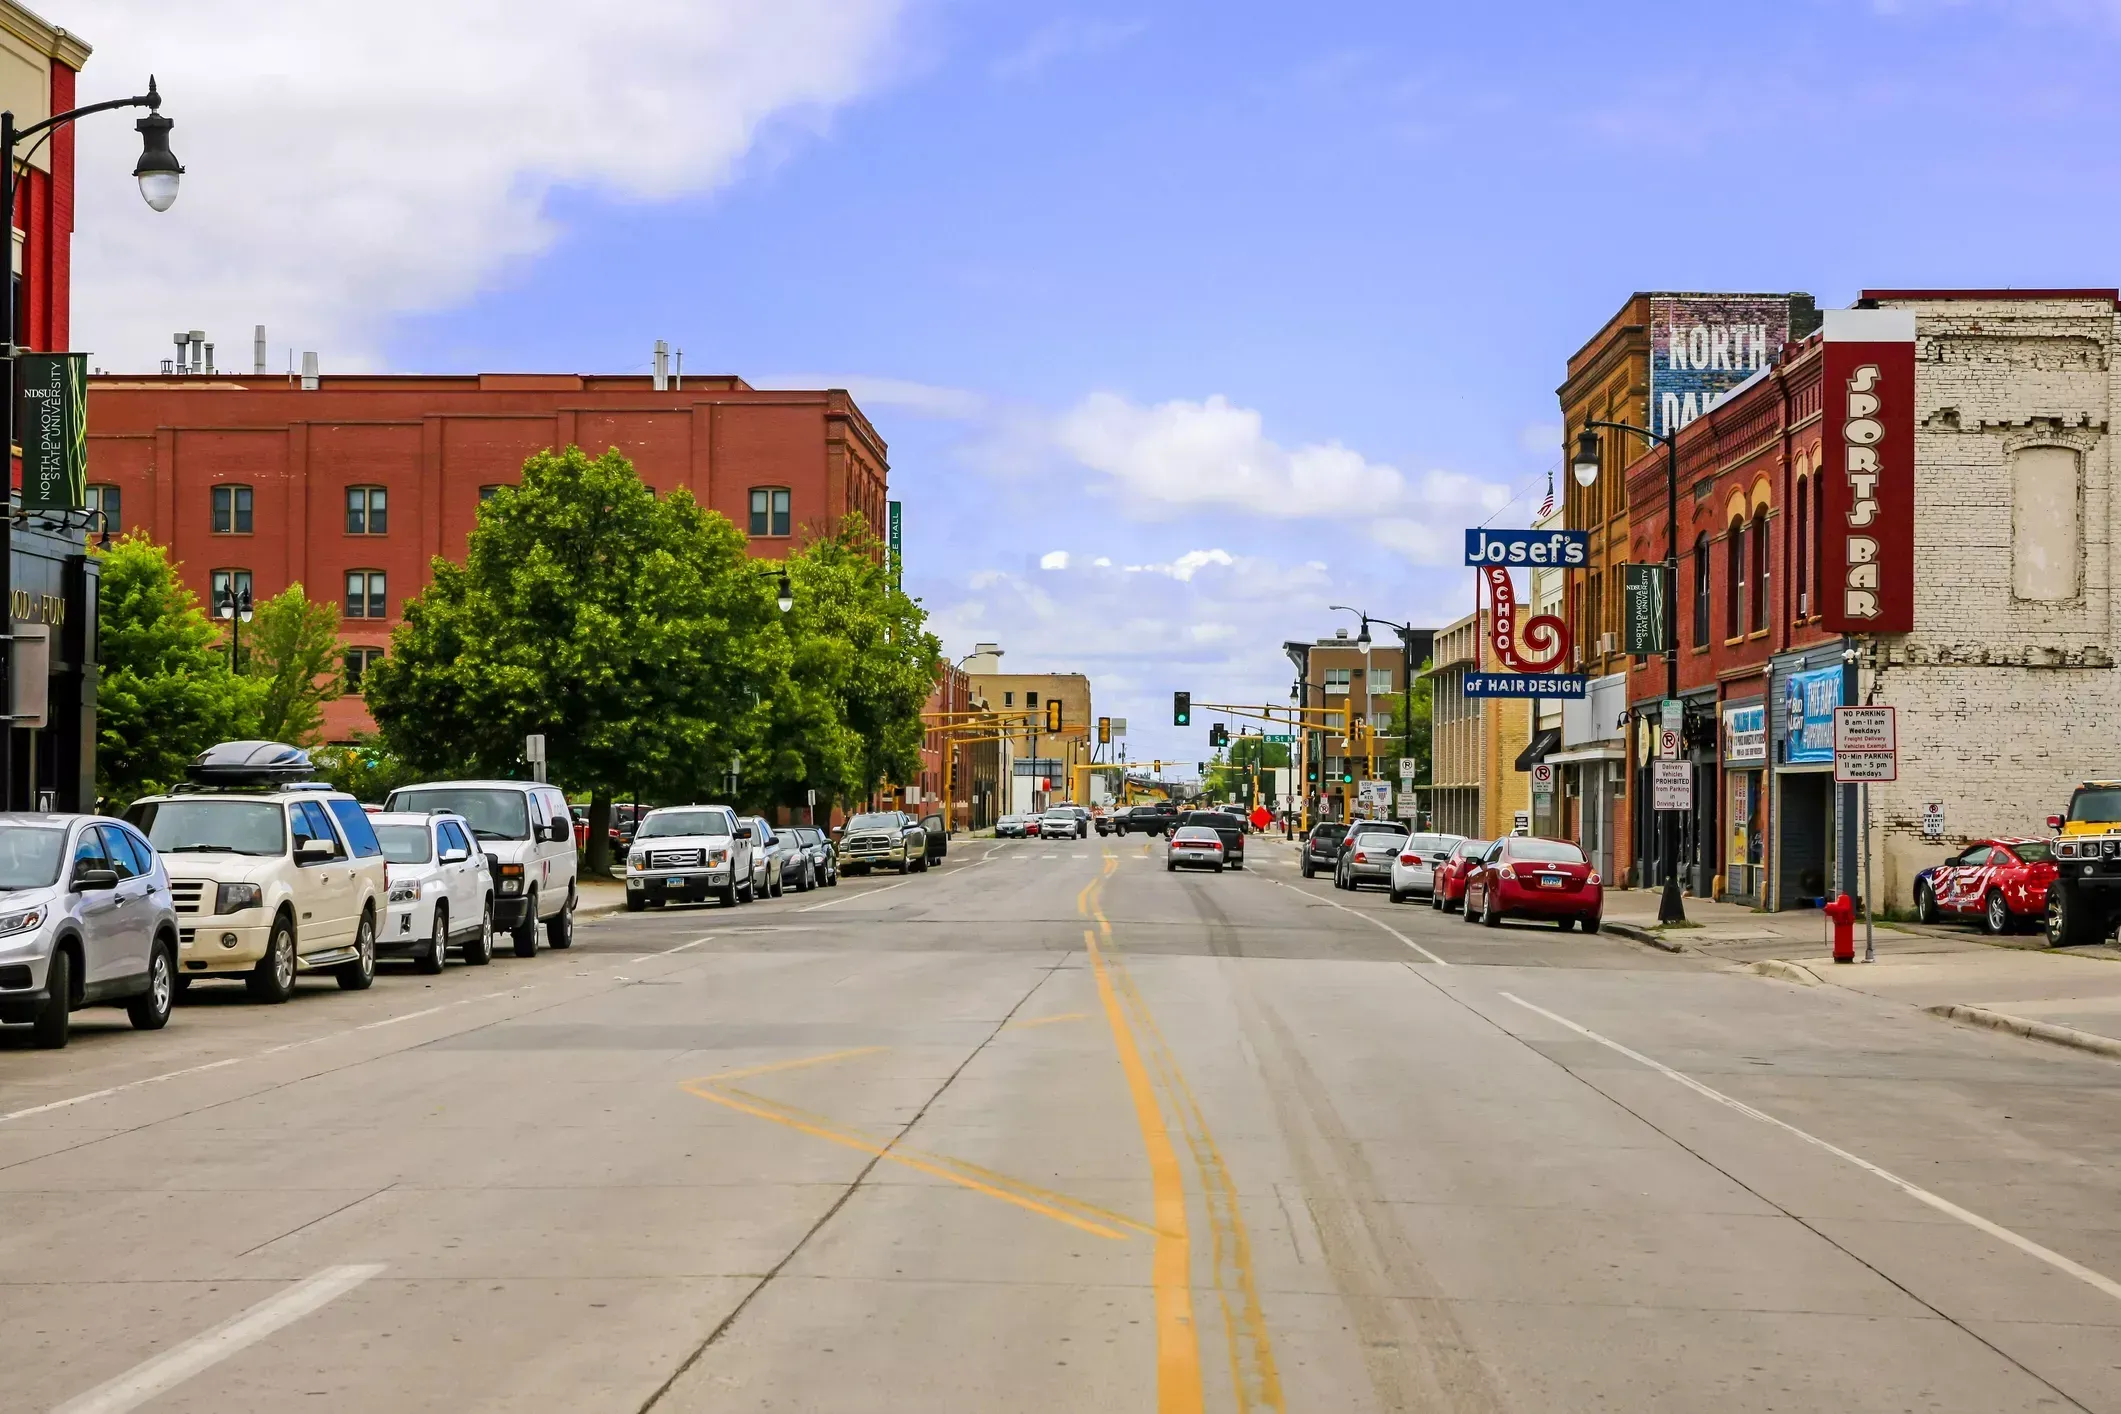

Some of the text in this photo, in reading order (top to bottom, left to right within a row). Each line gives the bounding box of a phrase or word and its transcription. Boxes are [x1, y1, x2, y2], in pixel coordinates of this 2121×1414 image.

[1669, 324, 1766, 370] NORTH
[24, 389, 51, 398] NDSU
[51, 361, 61, 480] STATE UNIVERSITY
[41, 398, 51, 500] NORTH DAKOTA
[1843, 364, 1884, 619] SPORTS BAR
[1469, 532, 1584, 563] Josef's
[41, 594, 65, 625] FUN
[1492, 569, 1517, 666] SCHOOL
[1466, 679, 1582, 693] of HAIR DESIGN
[1791, 697, 1803, 713] BUD
[1789, 714, 1804, 730] LIGHT
[1848, 727, 1881, 735] Weekdays
[1661, 763, 1683, 771] Delivery
[1849, 770, 1882, 778] Weekdays
[1656, 800, 1675, 808] Driving
